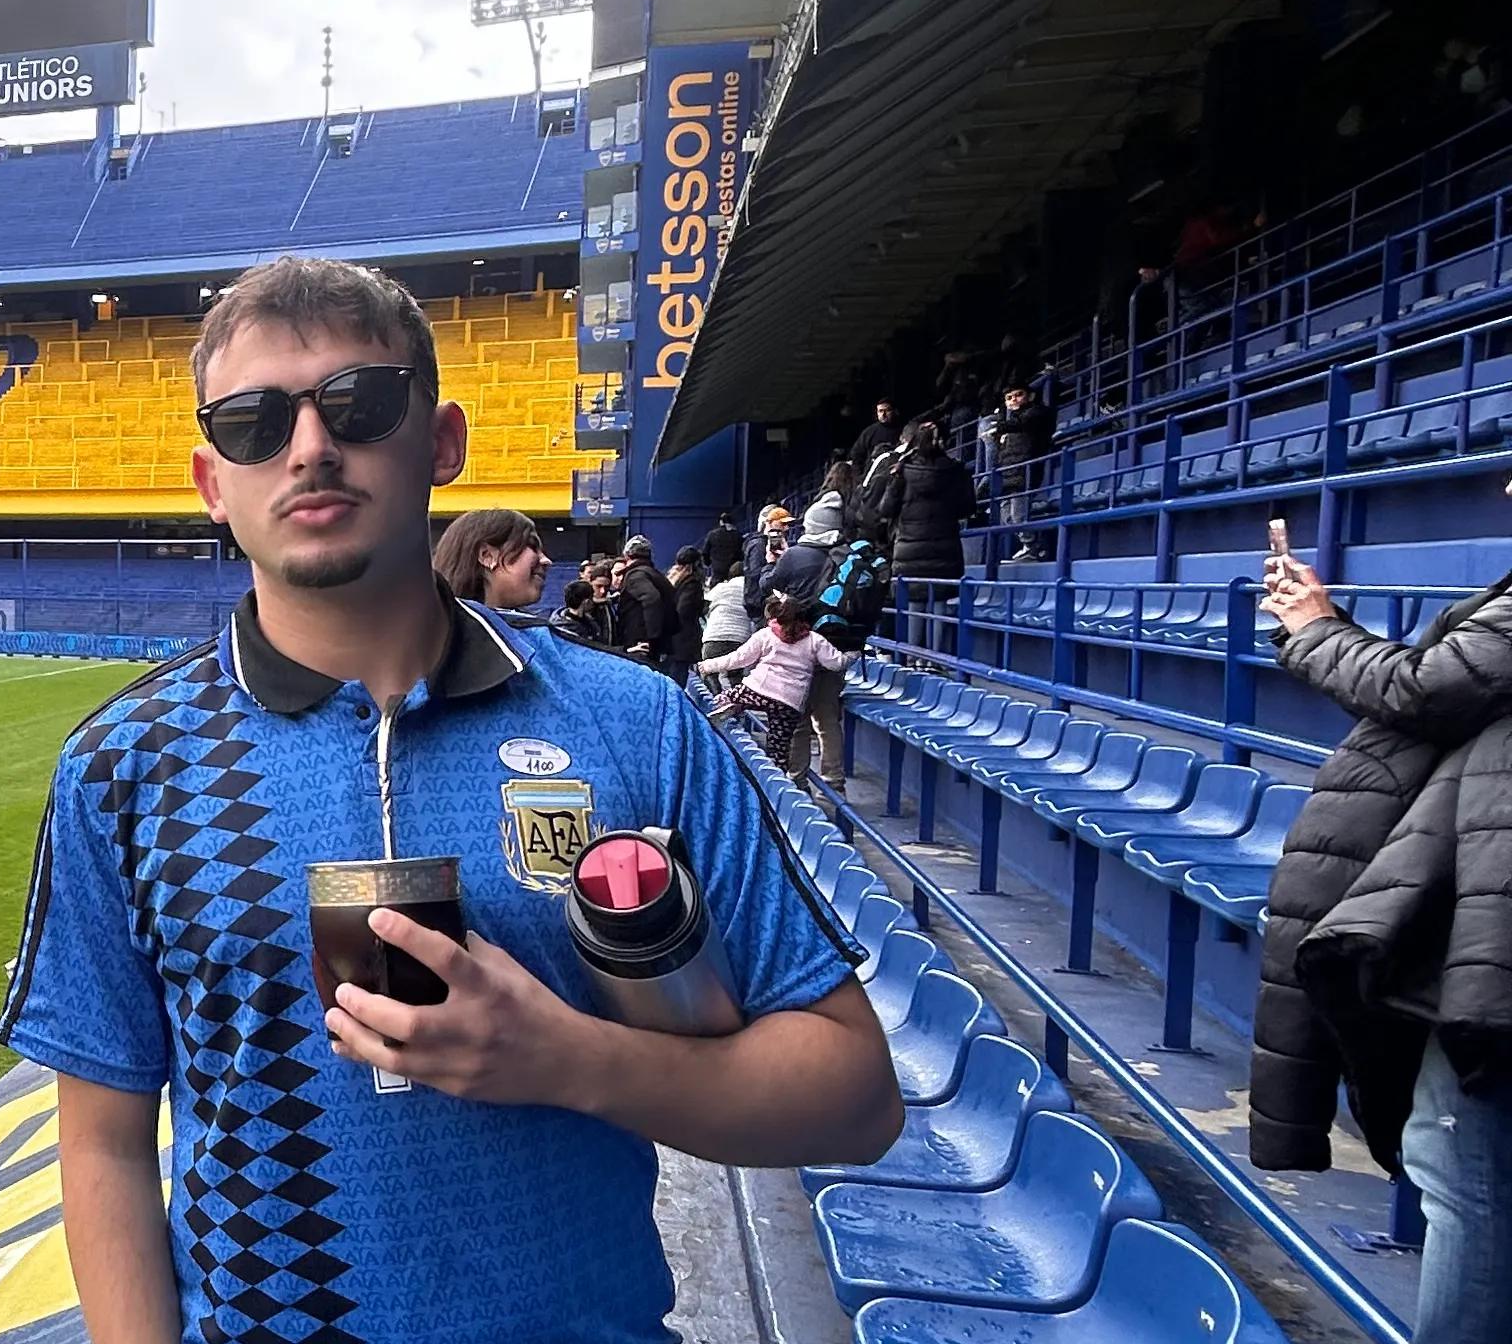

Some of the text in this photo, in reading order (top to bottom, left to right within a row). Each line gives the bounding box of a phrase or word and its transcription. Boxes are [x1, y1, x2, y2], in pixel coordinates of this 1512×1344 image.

[718, 71, 740, 145] online
[642, 71, 713, 389] betsson
[527, 808, 584, 866] AFA
